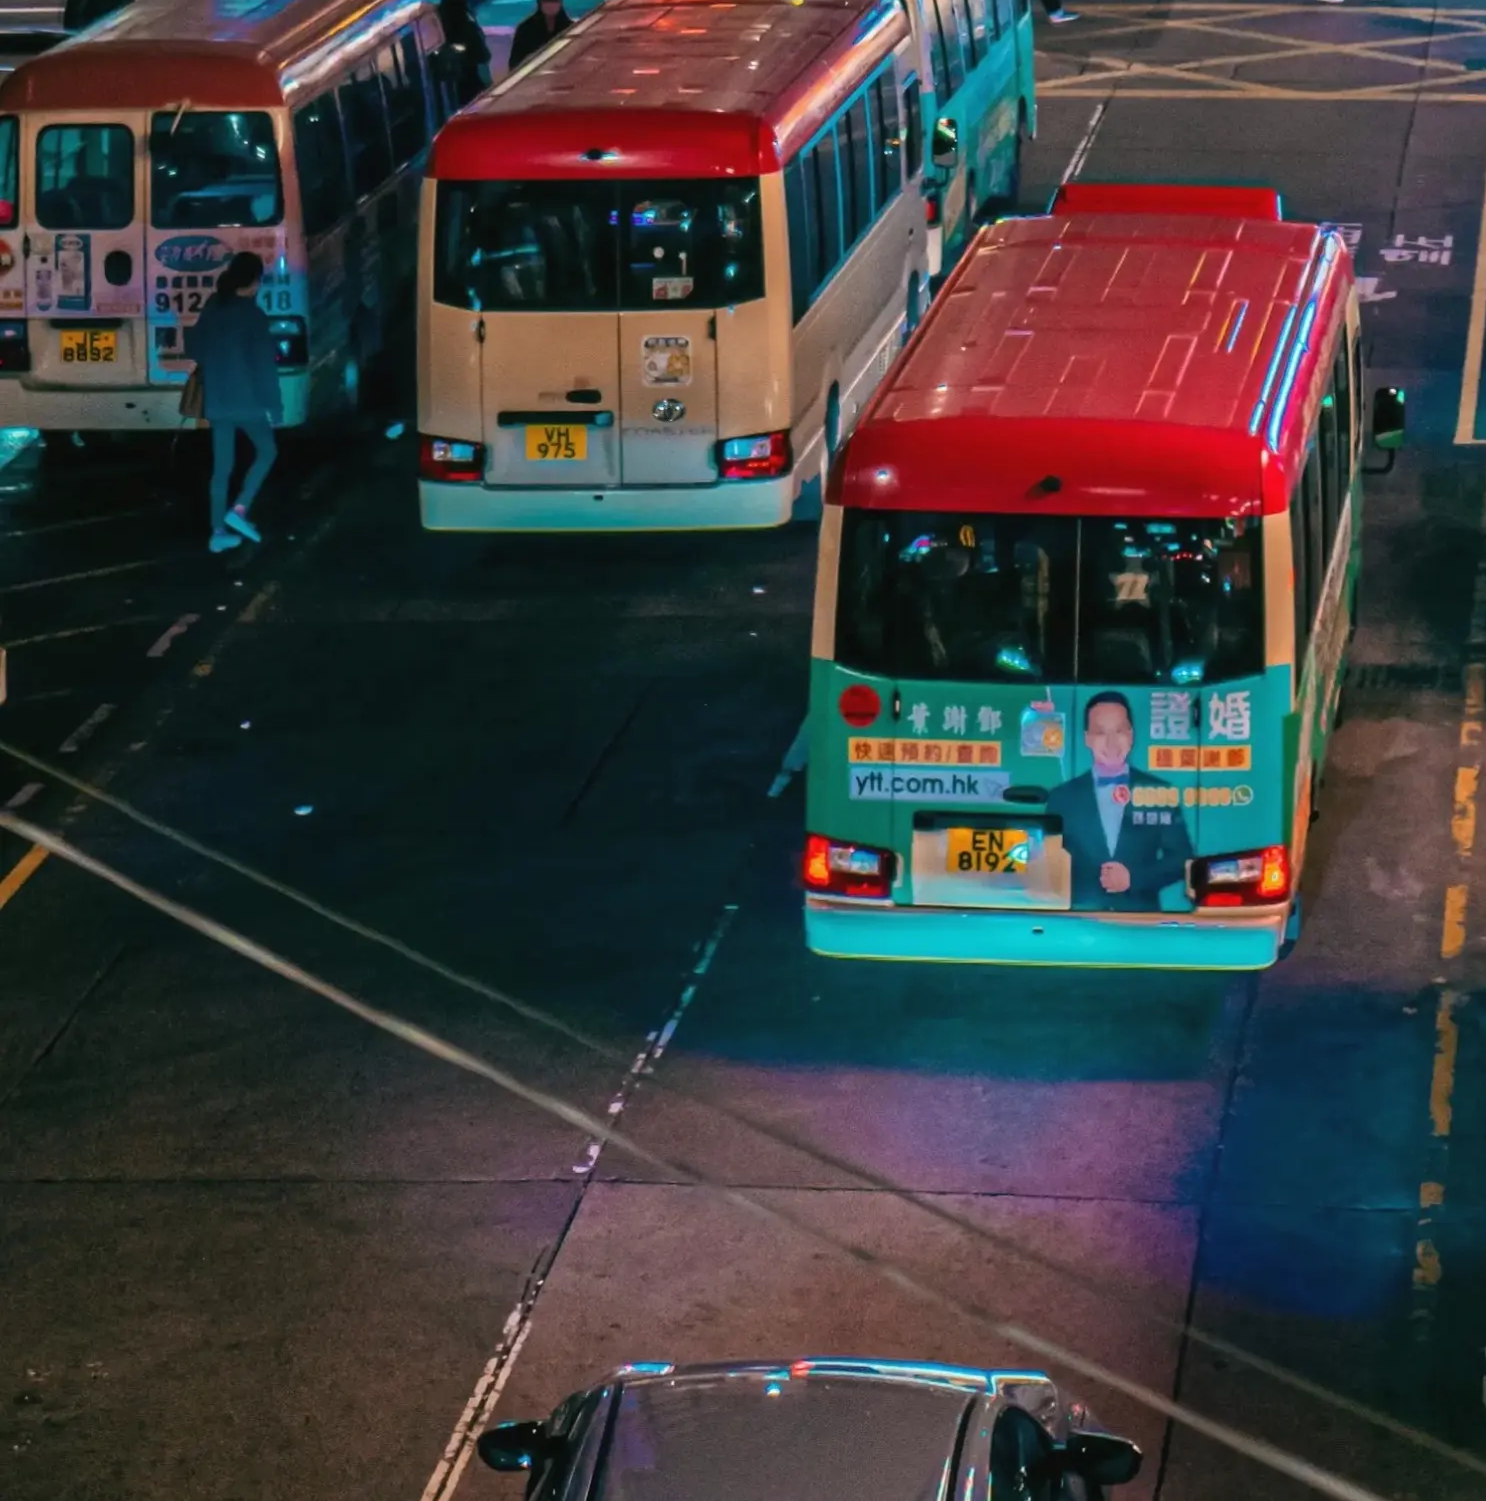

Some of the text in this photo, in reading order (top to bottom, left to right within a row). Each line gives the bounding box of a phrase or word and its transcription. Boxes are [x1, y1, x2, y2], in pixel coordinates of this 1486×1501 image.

[544, 426, 570, 443] VH
[537, 442, 577, 459] 975
[1150, 691, 1251, 741] 證婚
[855, 771, 979, 797] ytt.com.hk
[971, 831, 1004, 851] EN
[957, 850, 1017, 873] 8192
